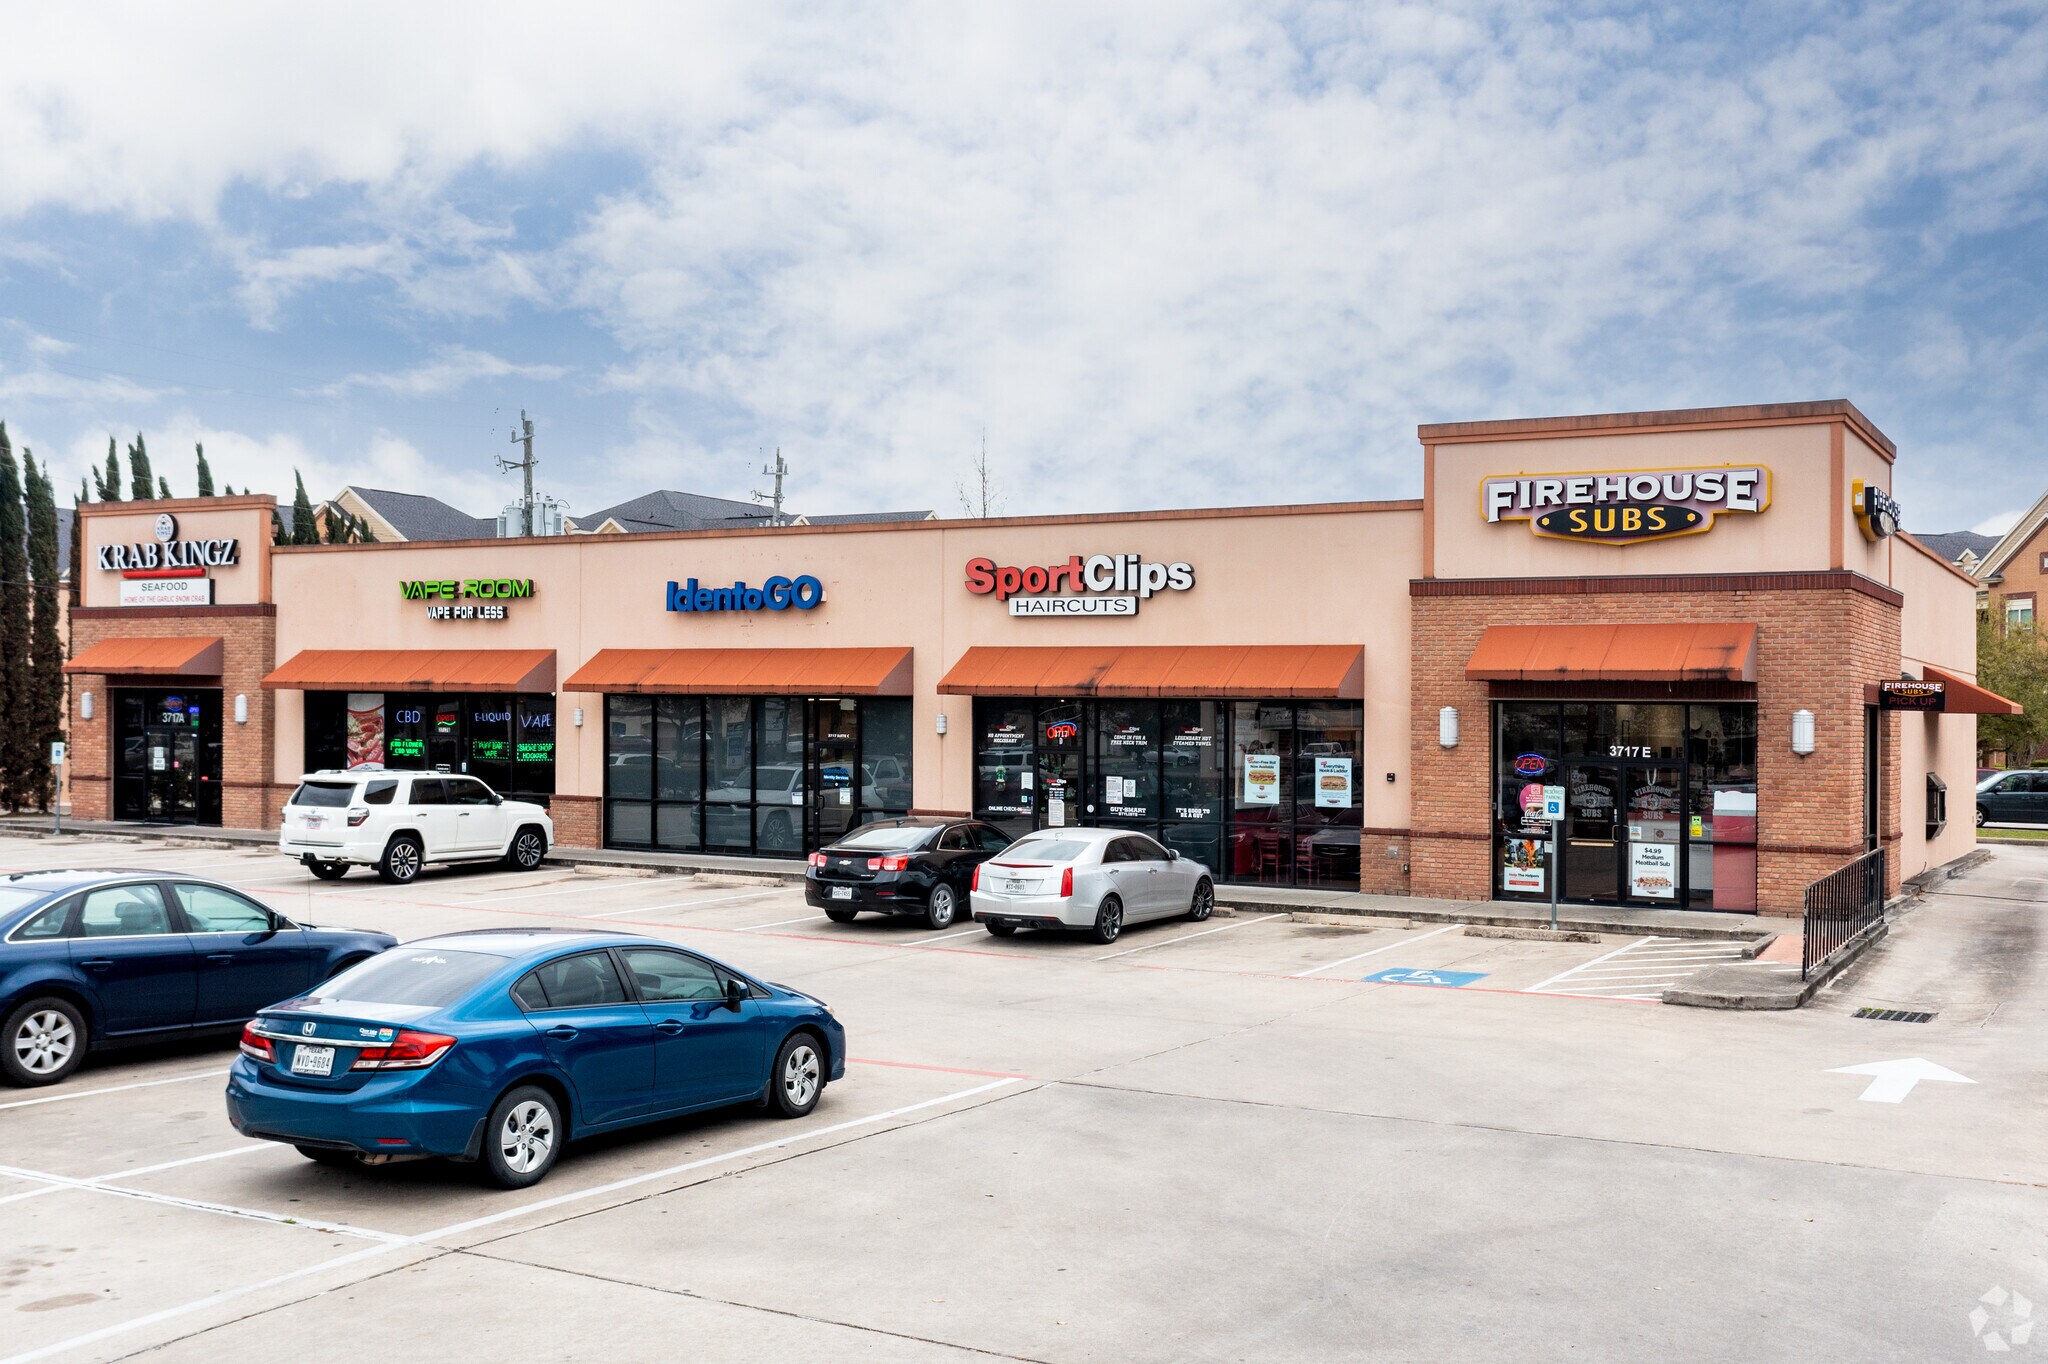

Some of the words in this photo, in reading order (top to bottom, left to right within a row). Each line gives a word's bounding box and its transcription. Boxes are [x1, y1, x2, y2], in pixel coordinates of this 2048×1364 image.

[1487, 469, 1759, 523] FIREHOUSE
[1570, 507, 1666, 532] SUBS
[97, 542, 159, 570] KRAB
[162, 539, 237, 567] KINGZ
[141, 582, 188, 591] SEAFOOD
[399, 580, 457, 599] VAPE
[463, 578, 534, 598] ROOM
[666, 574, 823, 612] IdentoGO
[1016, 599, 1128, 613] HAIRCUTS
[426, 607, 451, 619] VAPE
[454, 606, 474, 619] FOR
[477, 606, 505, 619] LESS
[1884, 683, 1942, 692] FIREHOUSE
[162, 712, 185, 723] 3717A
[396, 710, 421, 723] CBD
[474, 711, 512, 722] E-LIQUID
[520, 713, 552, 728] VAPE
[1047, 725, 1075, 738] OPEN
[1610, 746, 1640, 758] 3717
[1642, 746, 1652, 758] E
[1514, 758, 1546, 770] OPEN
[1573, 784, 1611, 795] FIREHOUSE
[1634, 786, 1673, 797] FIREHOUSE
[1582, 808, 1602, 818] SUBS
[1642, 811, 1664, 819] SUBS
